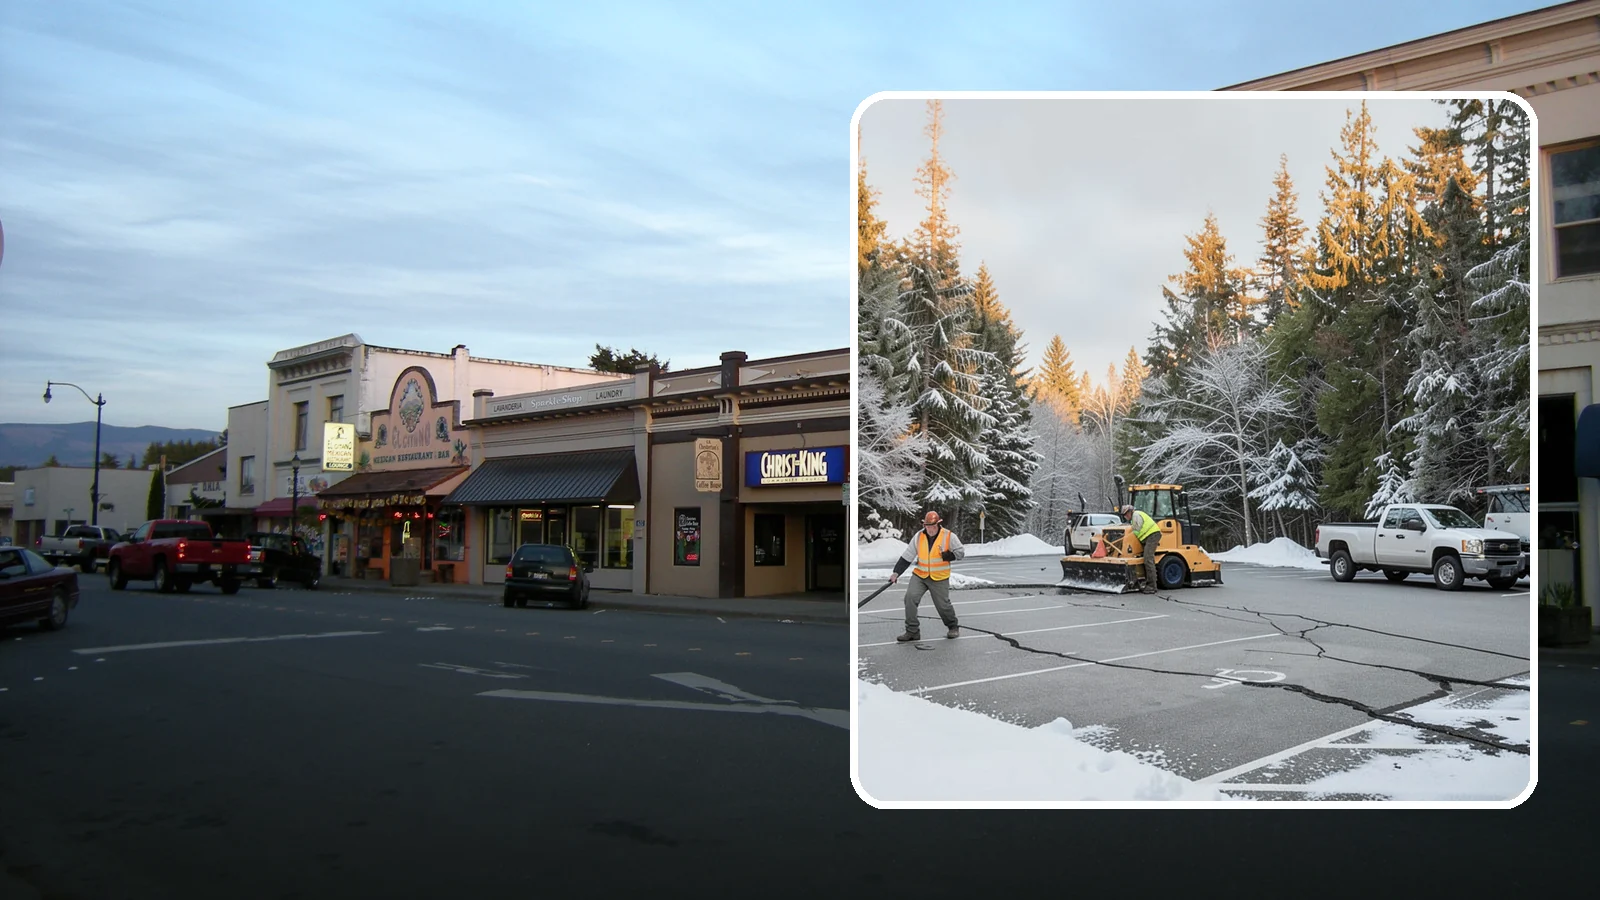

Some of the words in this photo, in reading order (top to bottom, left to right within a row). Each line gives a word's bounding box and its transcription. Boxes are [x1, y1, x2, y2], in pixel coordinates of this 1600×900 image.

[531, 397, 560, 409] Sparkle
[562, 394, 582, 406] Shop
[595, 389, 624, 400] LAUNDRY
[493, 402, 522, 412] LAVANDERIA
[373, 455, 396, 464] MEXICAN
[398, 451, 433, 462] RESTAURANT
[438, 450, 450, 459] BAR
[761, 451, 797, 478] CHRIST
[799, 450, 827, 476] KING
